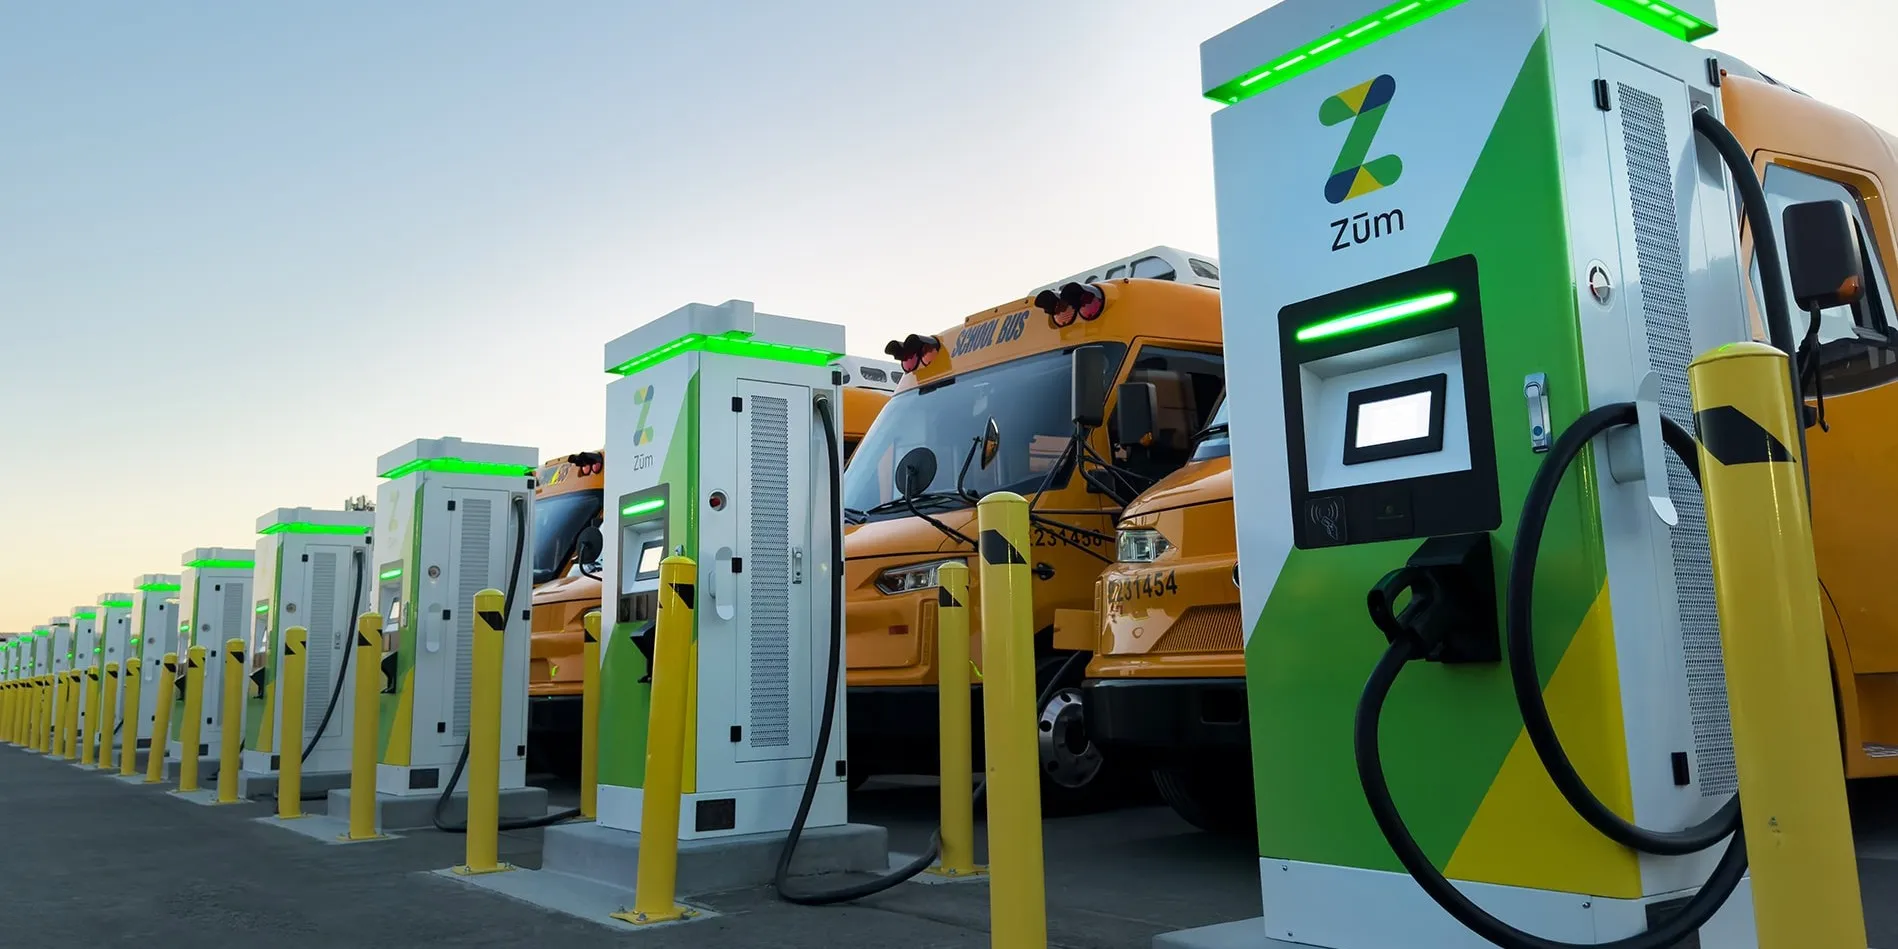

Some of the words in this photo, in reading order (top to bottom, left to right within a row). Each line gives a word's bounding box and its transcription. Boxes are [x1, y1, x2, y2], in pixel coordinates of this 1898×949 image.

[1330, 208, 1404, 251] Zūm
[951, 319, 999, 358] SCHOOL
[996, 310, 1030, 344] BUS
[633, 453, 654, 471] Zūm
